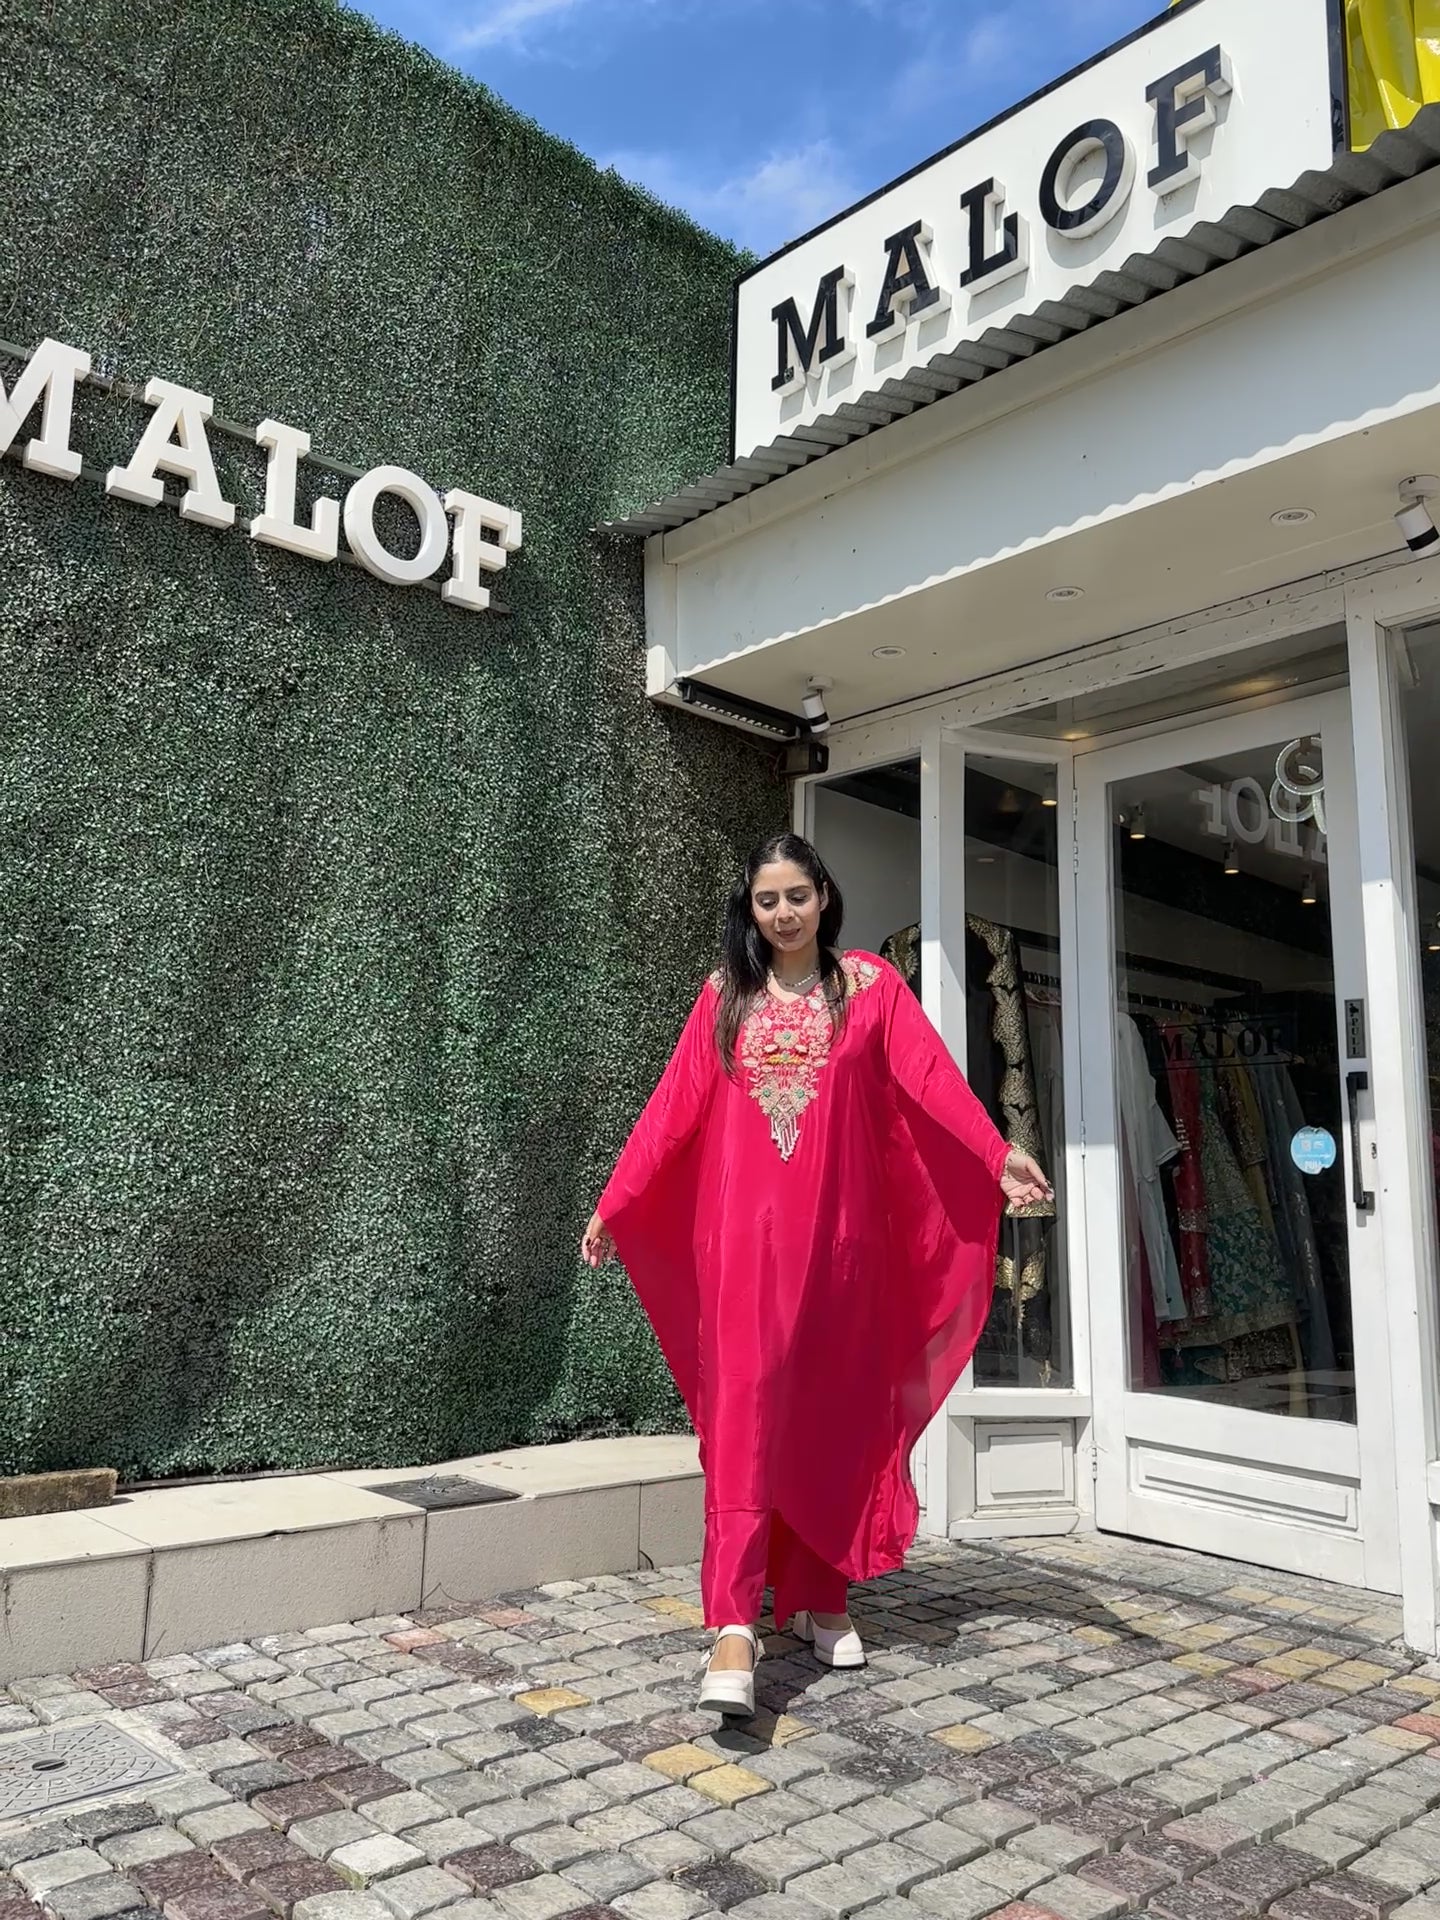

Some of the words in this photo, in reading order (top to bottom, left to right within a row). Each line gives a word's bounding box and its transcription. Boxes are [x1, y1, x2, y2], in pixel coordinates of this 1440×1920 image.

[771, 44, 1232, 397] MALOF
[0, 337, 522, 610] MALOF
[1160, 1025, 1283, 1062] MALOF
